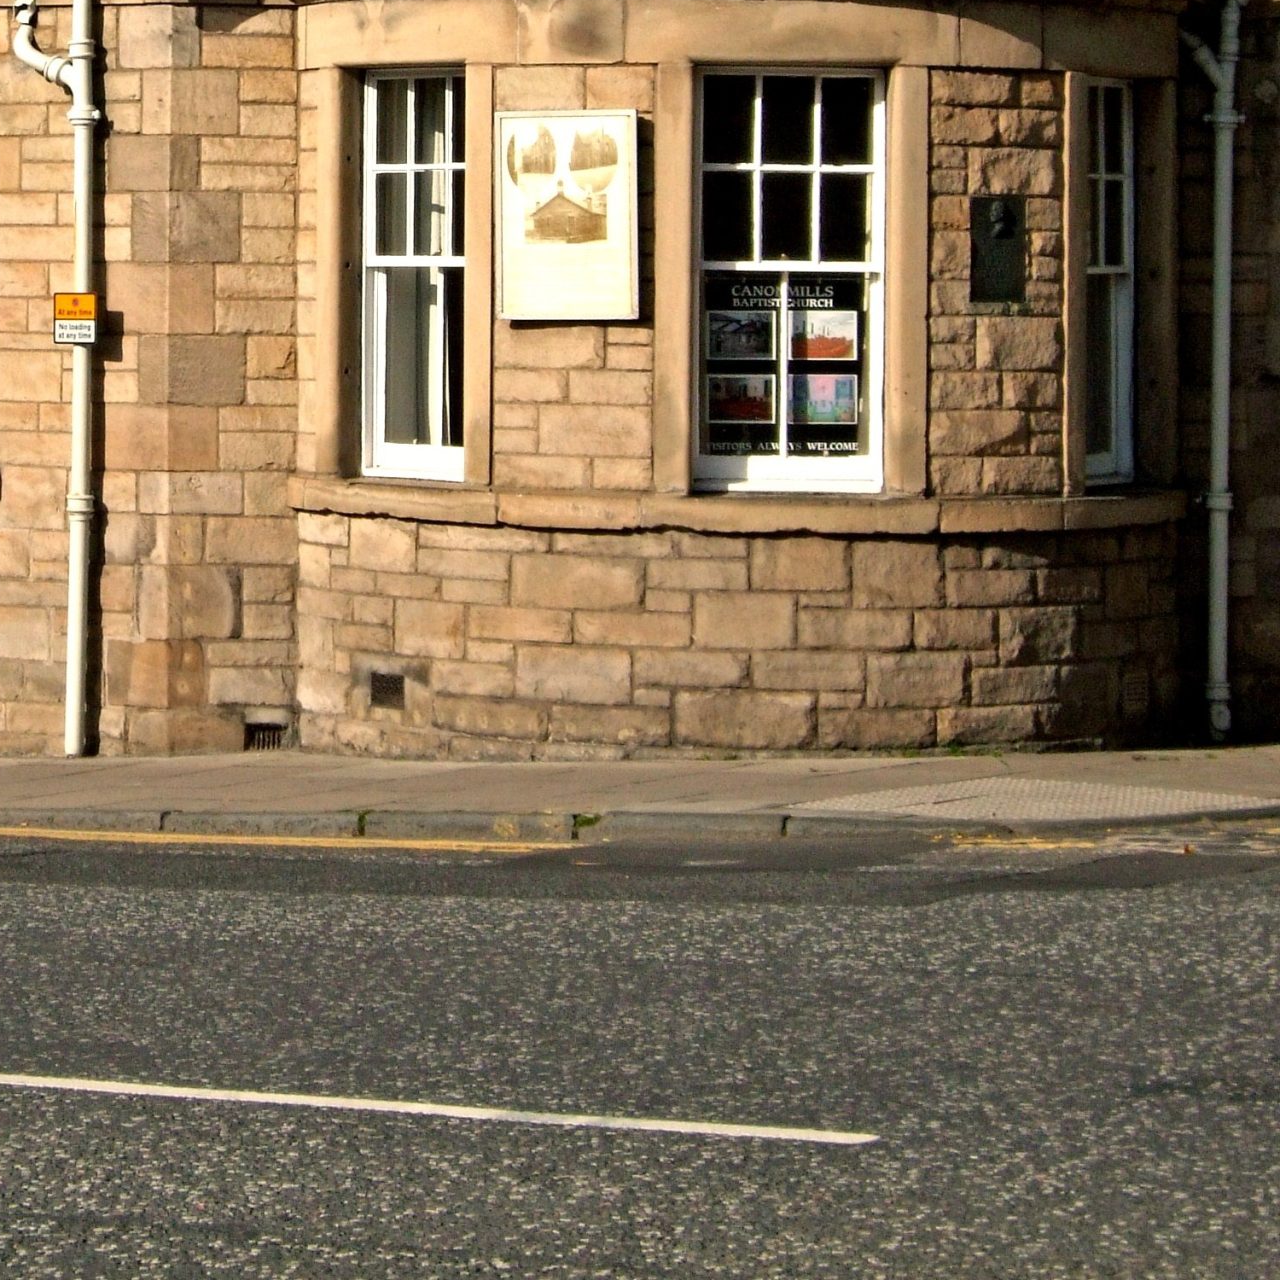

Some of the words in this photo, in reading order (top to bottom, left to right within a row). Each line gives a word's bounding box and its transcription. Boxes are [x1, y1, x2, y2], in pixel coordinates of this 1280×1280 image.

[732, 298, 781, 308] BAPTIST
[69, 323, 91, 331] loading
[806, 441, 859, 451] WELCOME
